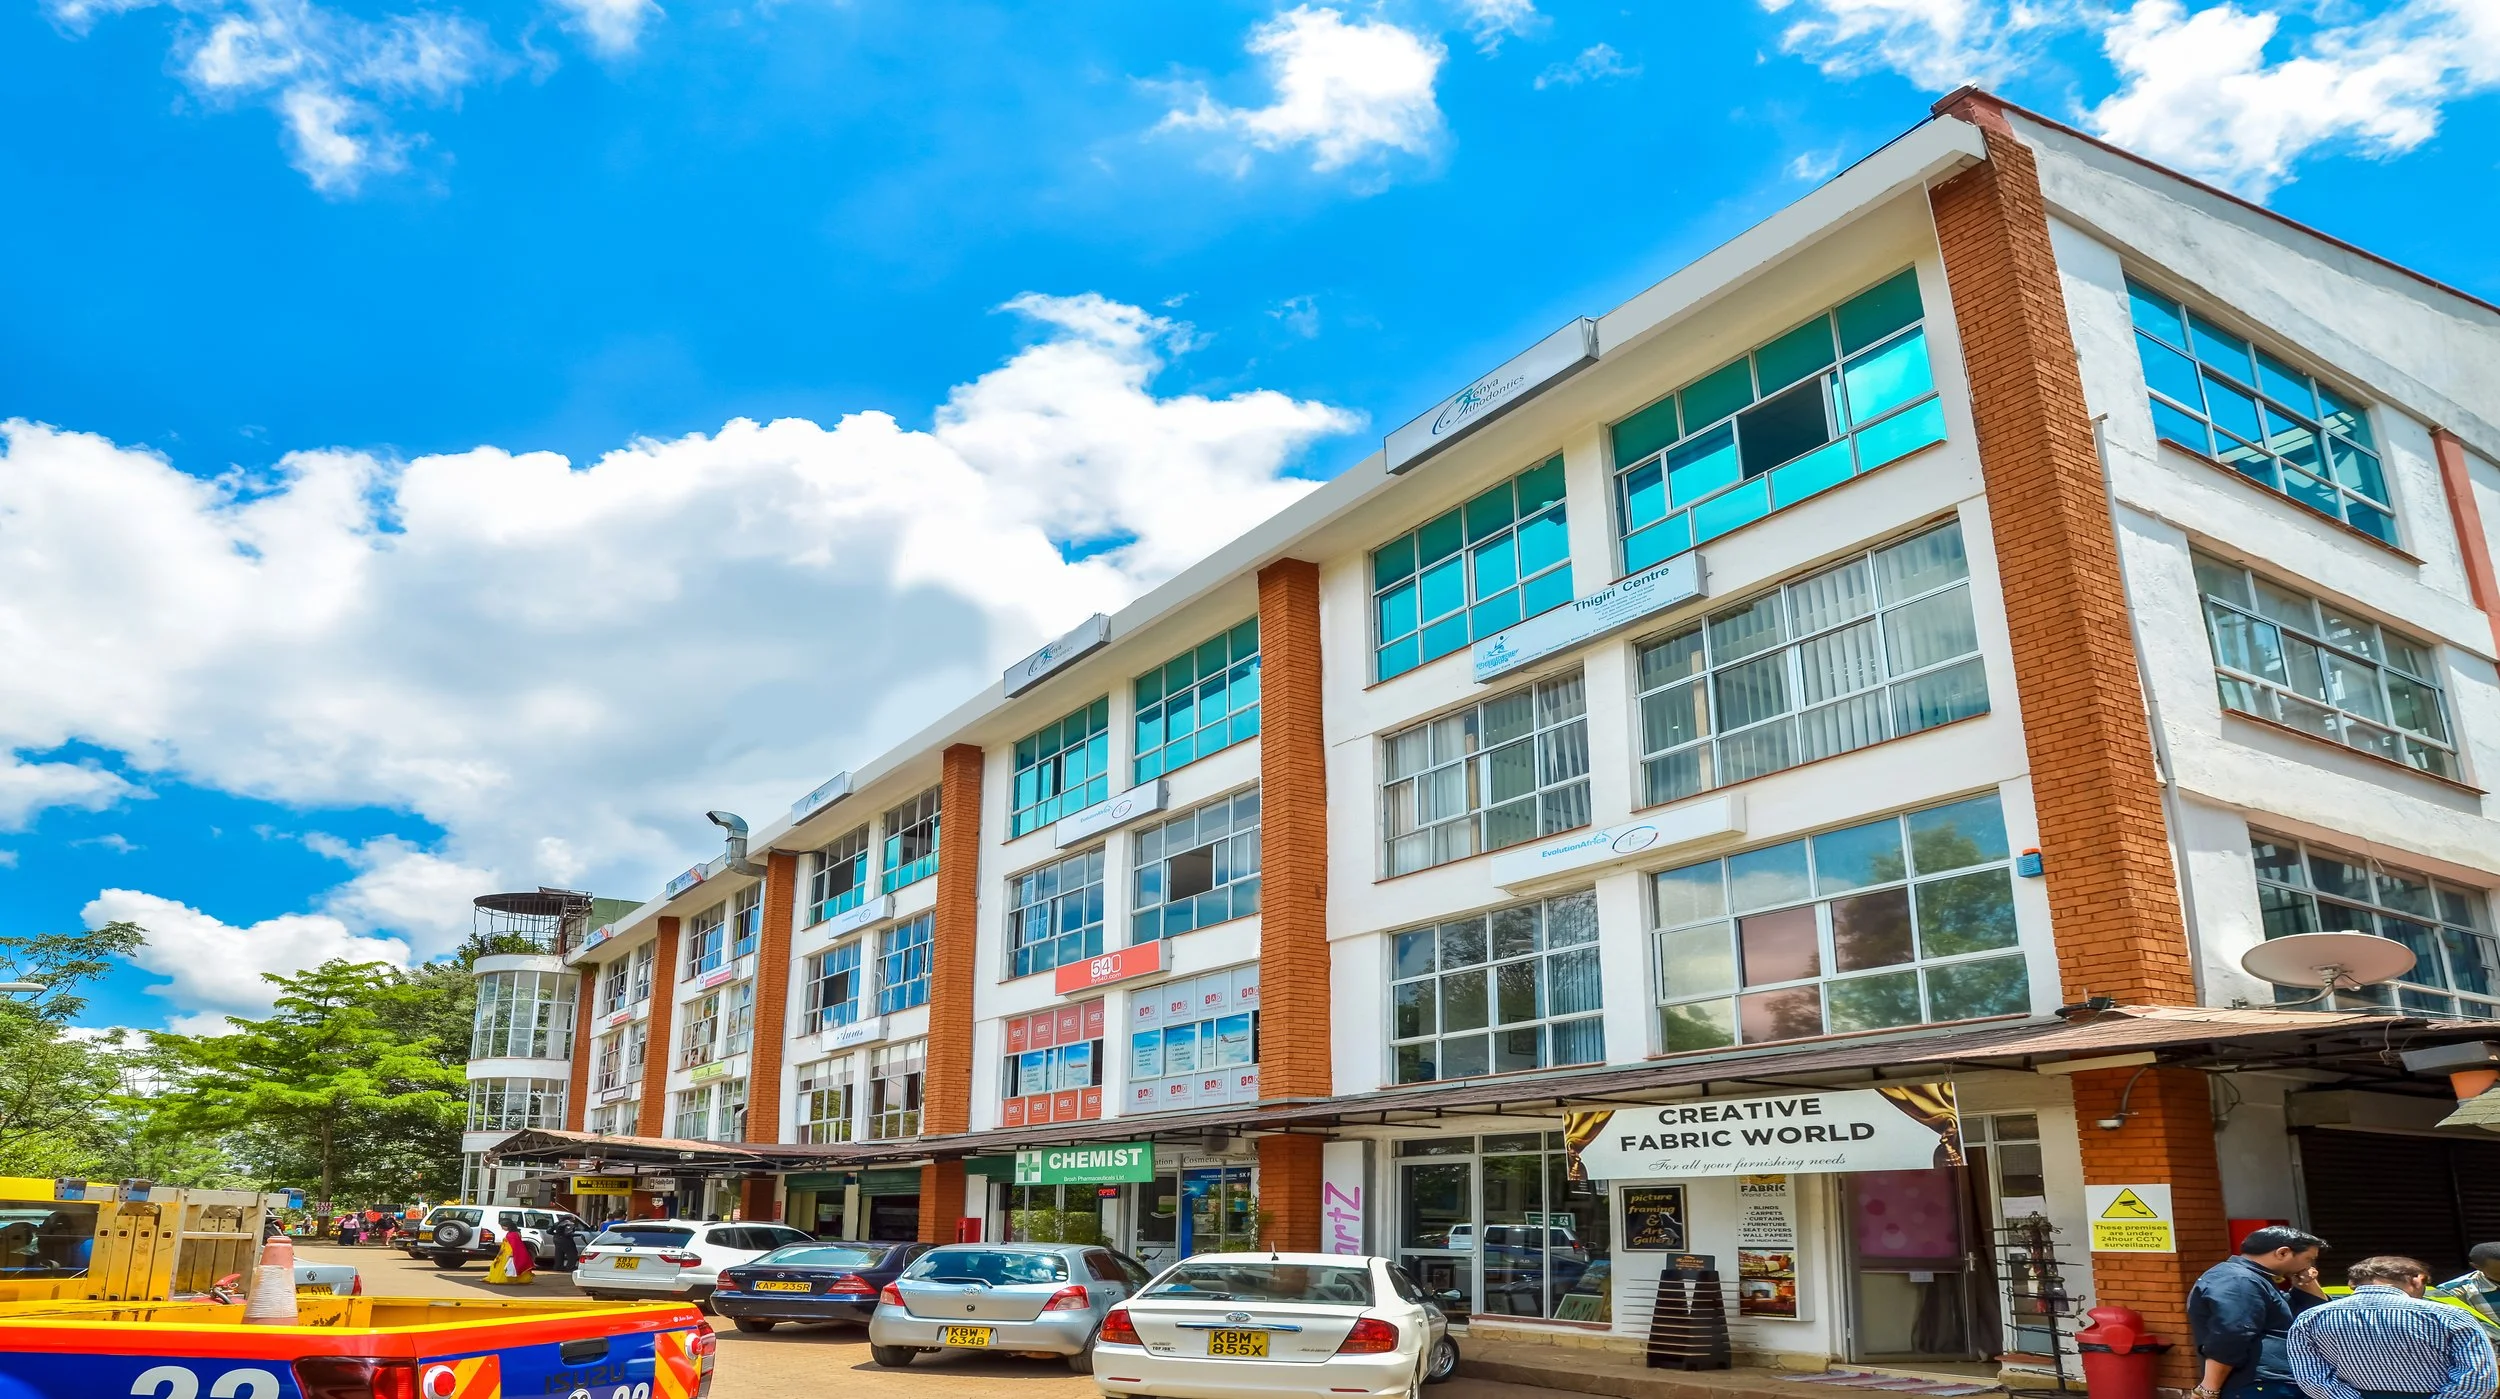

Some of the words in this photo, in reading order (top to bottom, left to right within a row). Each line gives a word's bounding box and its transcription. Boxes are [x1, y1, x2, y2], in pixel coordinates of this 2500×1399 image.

[1573, 588, 1615, 612] Thigiri
[1622, 567, 1669, 591] Centre
[1542, 836, 1607, 858] EvolutionAfrica
[1091, 954, 1121, 977] 540
[1658, 1098, 1821, 1125] CREATIVE
[1620, 1130, 1732, 1151] FABRIC
[1741, 1123, 1875, 1146] WORLD
[1049, 1148, 1142, 1169] CHEMIST
[1649, 1159, 1679, 1171] For
[1682, 1160, 1700, 1170] all
[1703, 1163, 1732, 1173] your
[1733, 1156, 1804, 1172] furnishing
[1810, 1153, 1846, 1165] needs
[1098, 1188, 1116, 1196] OPEN
[1631, 1193, 1673, 1204] picture
[1628, 1205, 1676, 1215] framing
[1646, 1215, 1660, 1226] &
[1633, 1236, 1676, 1246] Gallery
[755, 1281, 777, 1290] KAP
[782, 1282, 810, 1291] 235R
[950, 1328, 979, 1337] KBW
[1213, 1332, 1252, 1344] KBM
[949, 1336, 985, 1345] 634B
[1212, 1344, 1264, 1356] 855X
[545, 1363, 625, 1395] ISUZU
